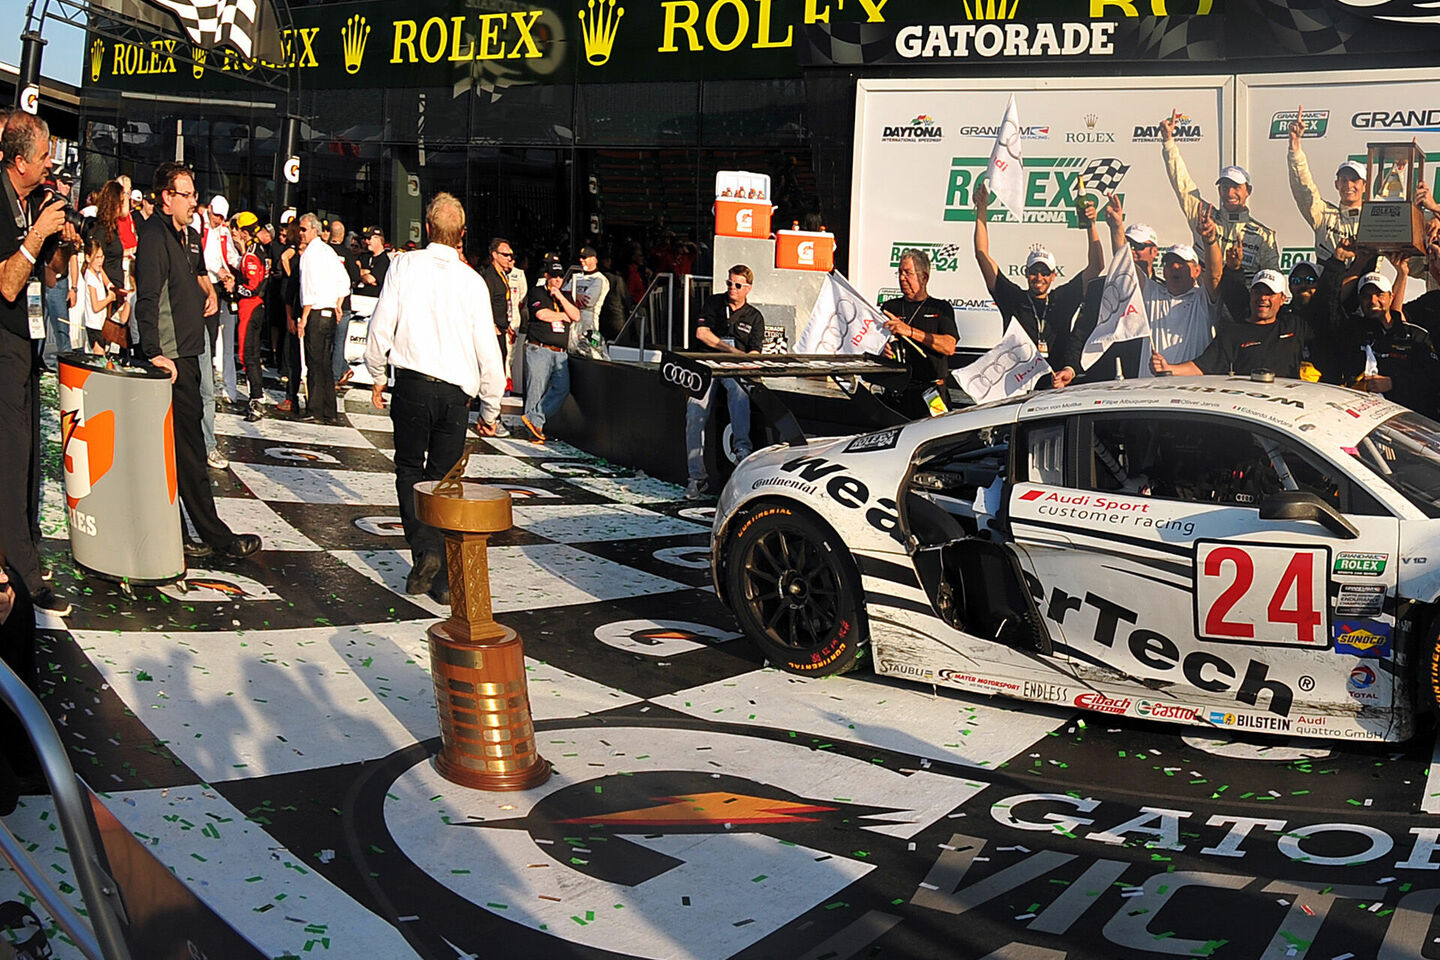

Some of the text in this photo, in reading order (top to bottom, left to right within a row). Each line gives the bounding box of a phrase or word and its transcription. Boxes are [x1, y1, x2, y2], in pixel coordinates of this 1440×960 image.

[111, 40, 177, 75] ROLEX
[389, 10, 544, 64] ROLEX
[895, 21, 1116, 58] GATORADE
[882, 126, 943, 138] DAYTONA
[1066, 132, 1115, 143] ROLEX
[938, 257, 959, 272] 24
[752, 475, 818, 495] Continental
[1045, 490, 1151, 515] Audi Sport
[1037, 504, 1196, 537] customer racing
[1340, 560, 1380, 571] ROLEX
[1203, 545, 1322, 643] 24
[1339, 633, 1385, 646] SUNOCO
[1023, 680, 1068, 702] ENDLESS
[1348, 690, 1379, 700] TOTAL
[1074, 693, 1132, 711] Eibach
[1151, 702, 1200, 721] Castrol
[1297, 715, 1327, 726] Audi
[1236, 713, 1291, 731] BILSTEIN
[1296, 726, 1384, 740] quattro GmbH
